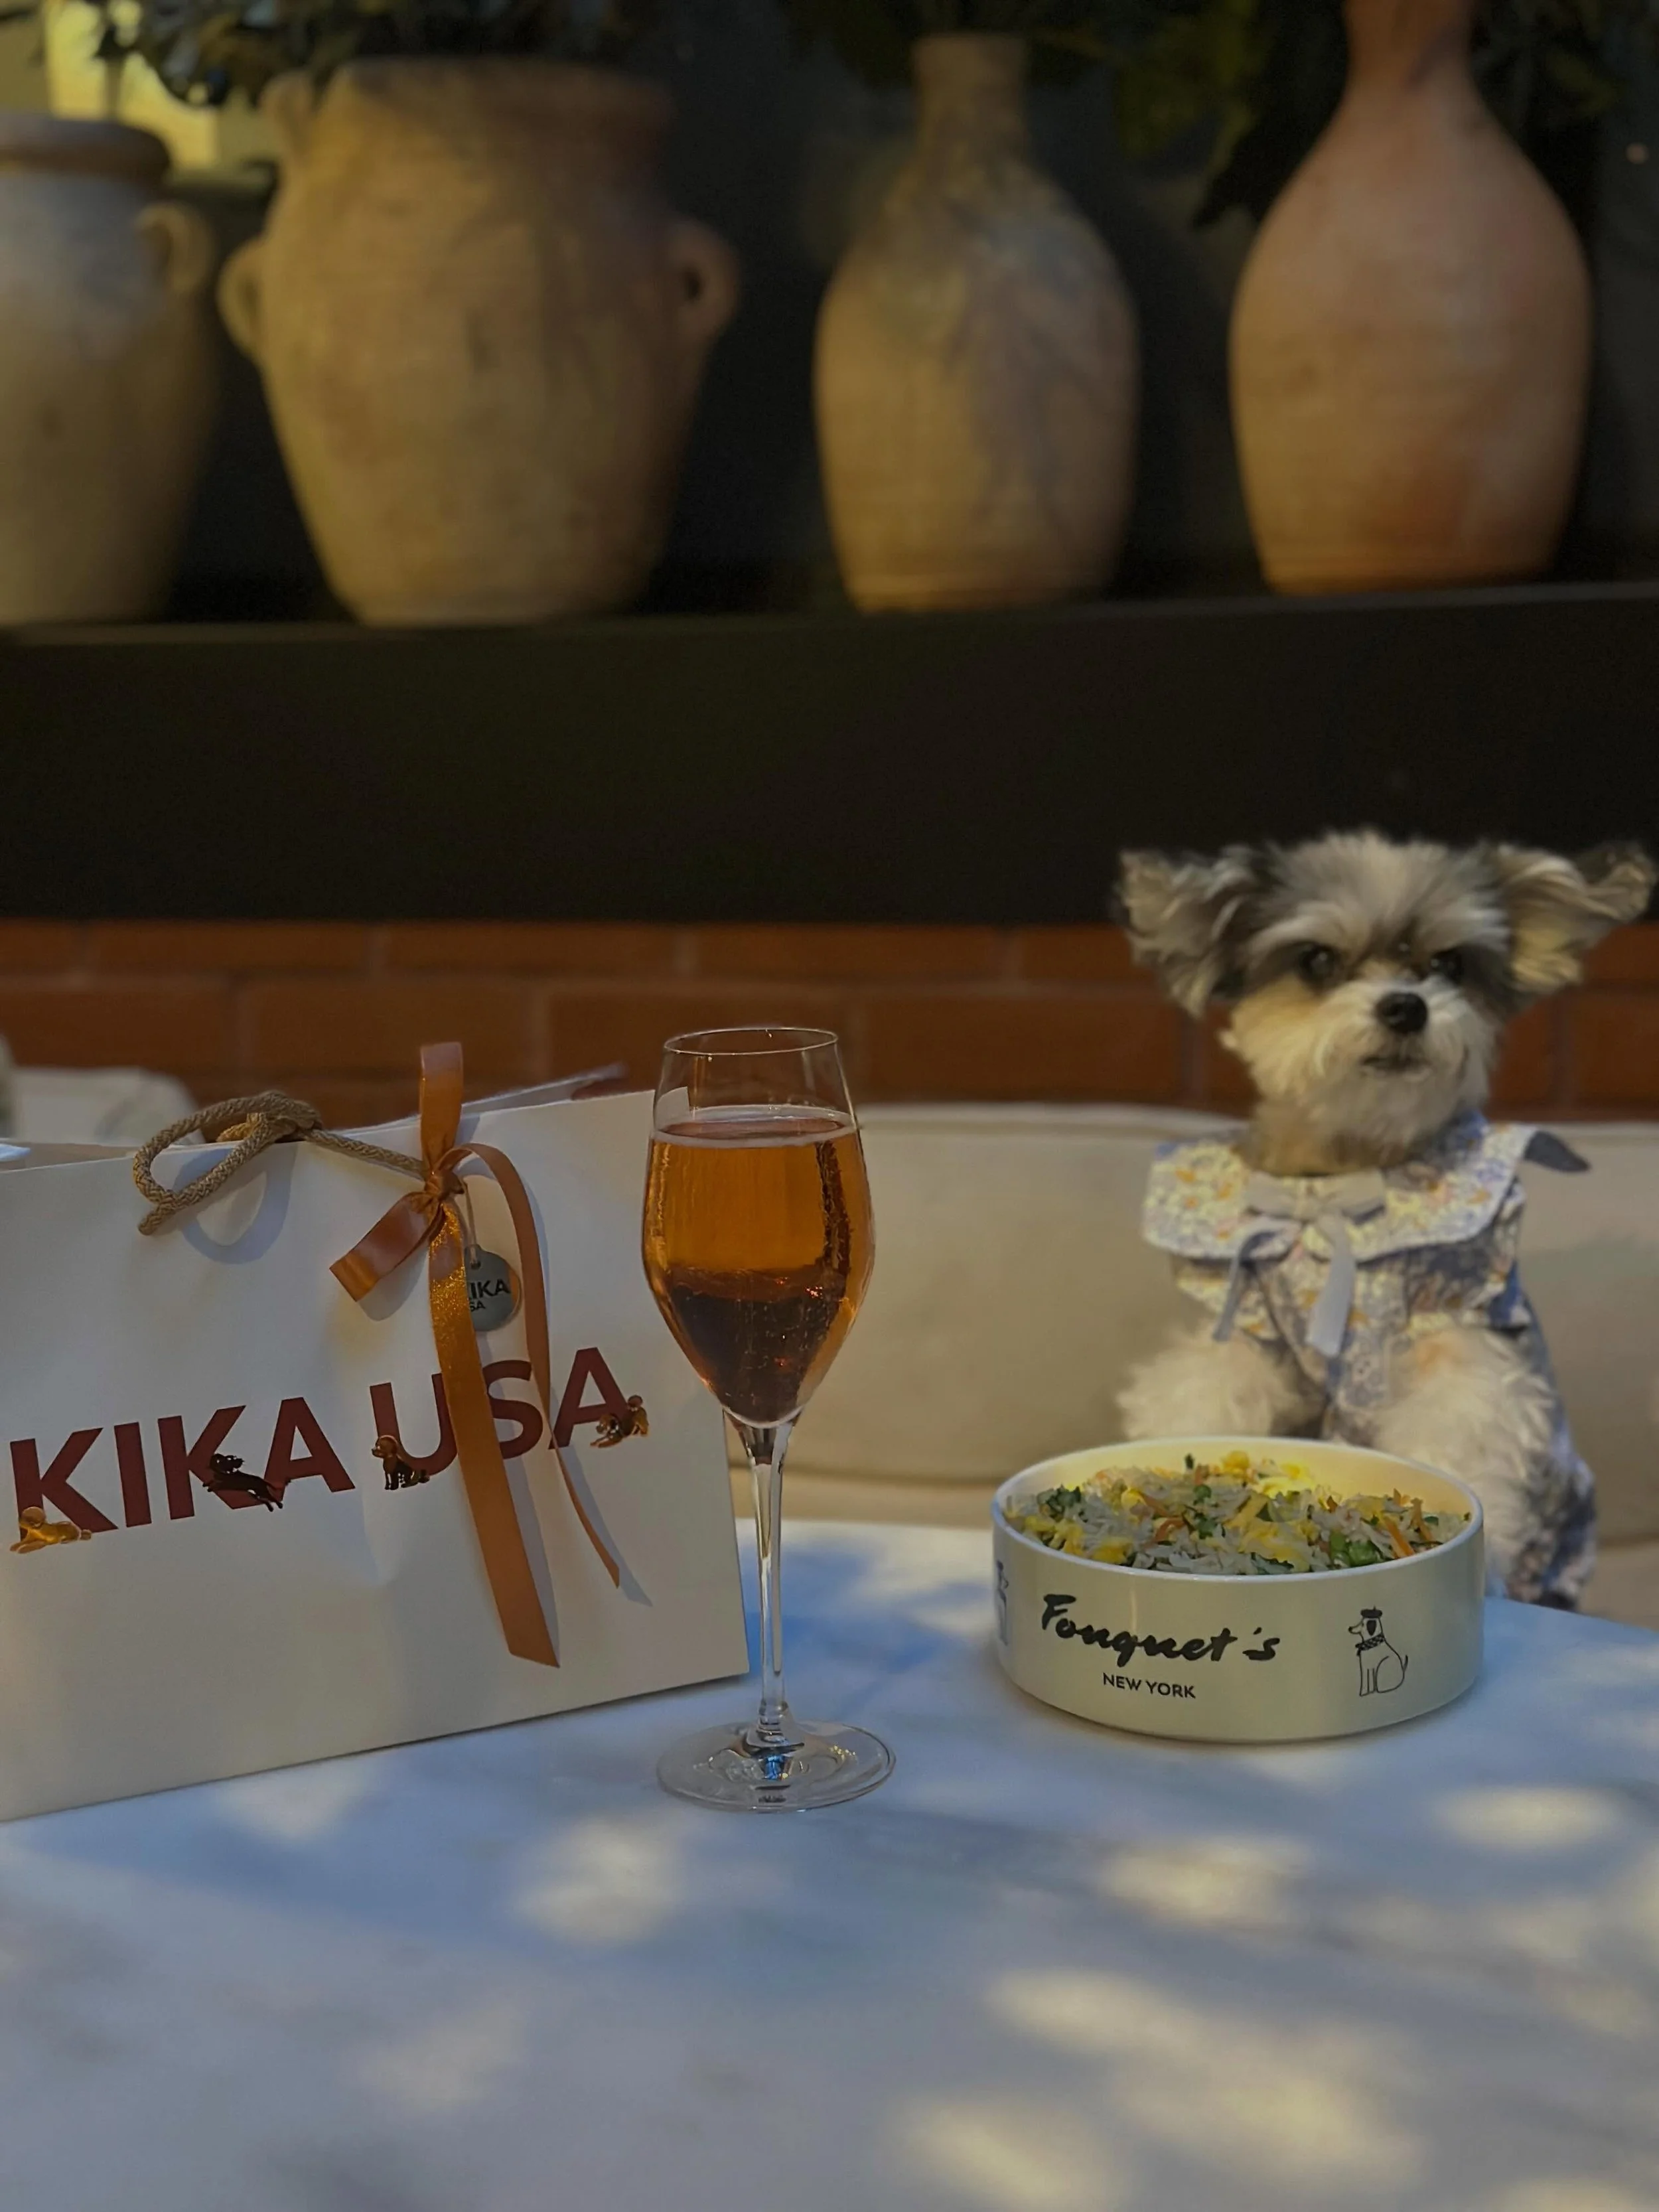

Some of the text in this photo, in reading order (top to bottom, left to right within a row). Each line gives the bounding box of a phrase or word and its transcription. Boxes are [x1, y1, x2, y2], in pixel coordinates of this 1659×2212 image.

[468, 1279, 511, 1299] IKA
[10, 1347, 634, 1542] KIKA USA
[1103, 1672, 1196, 1699] NEW YORK
